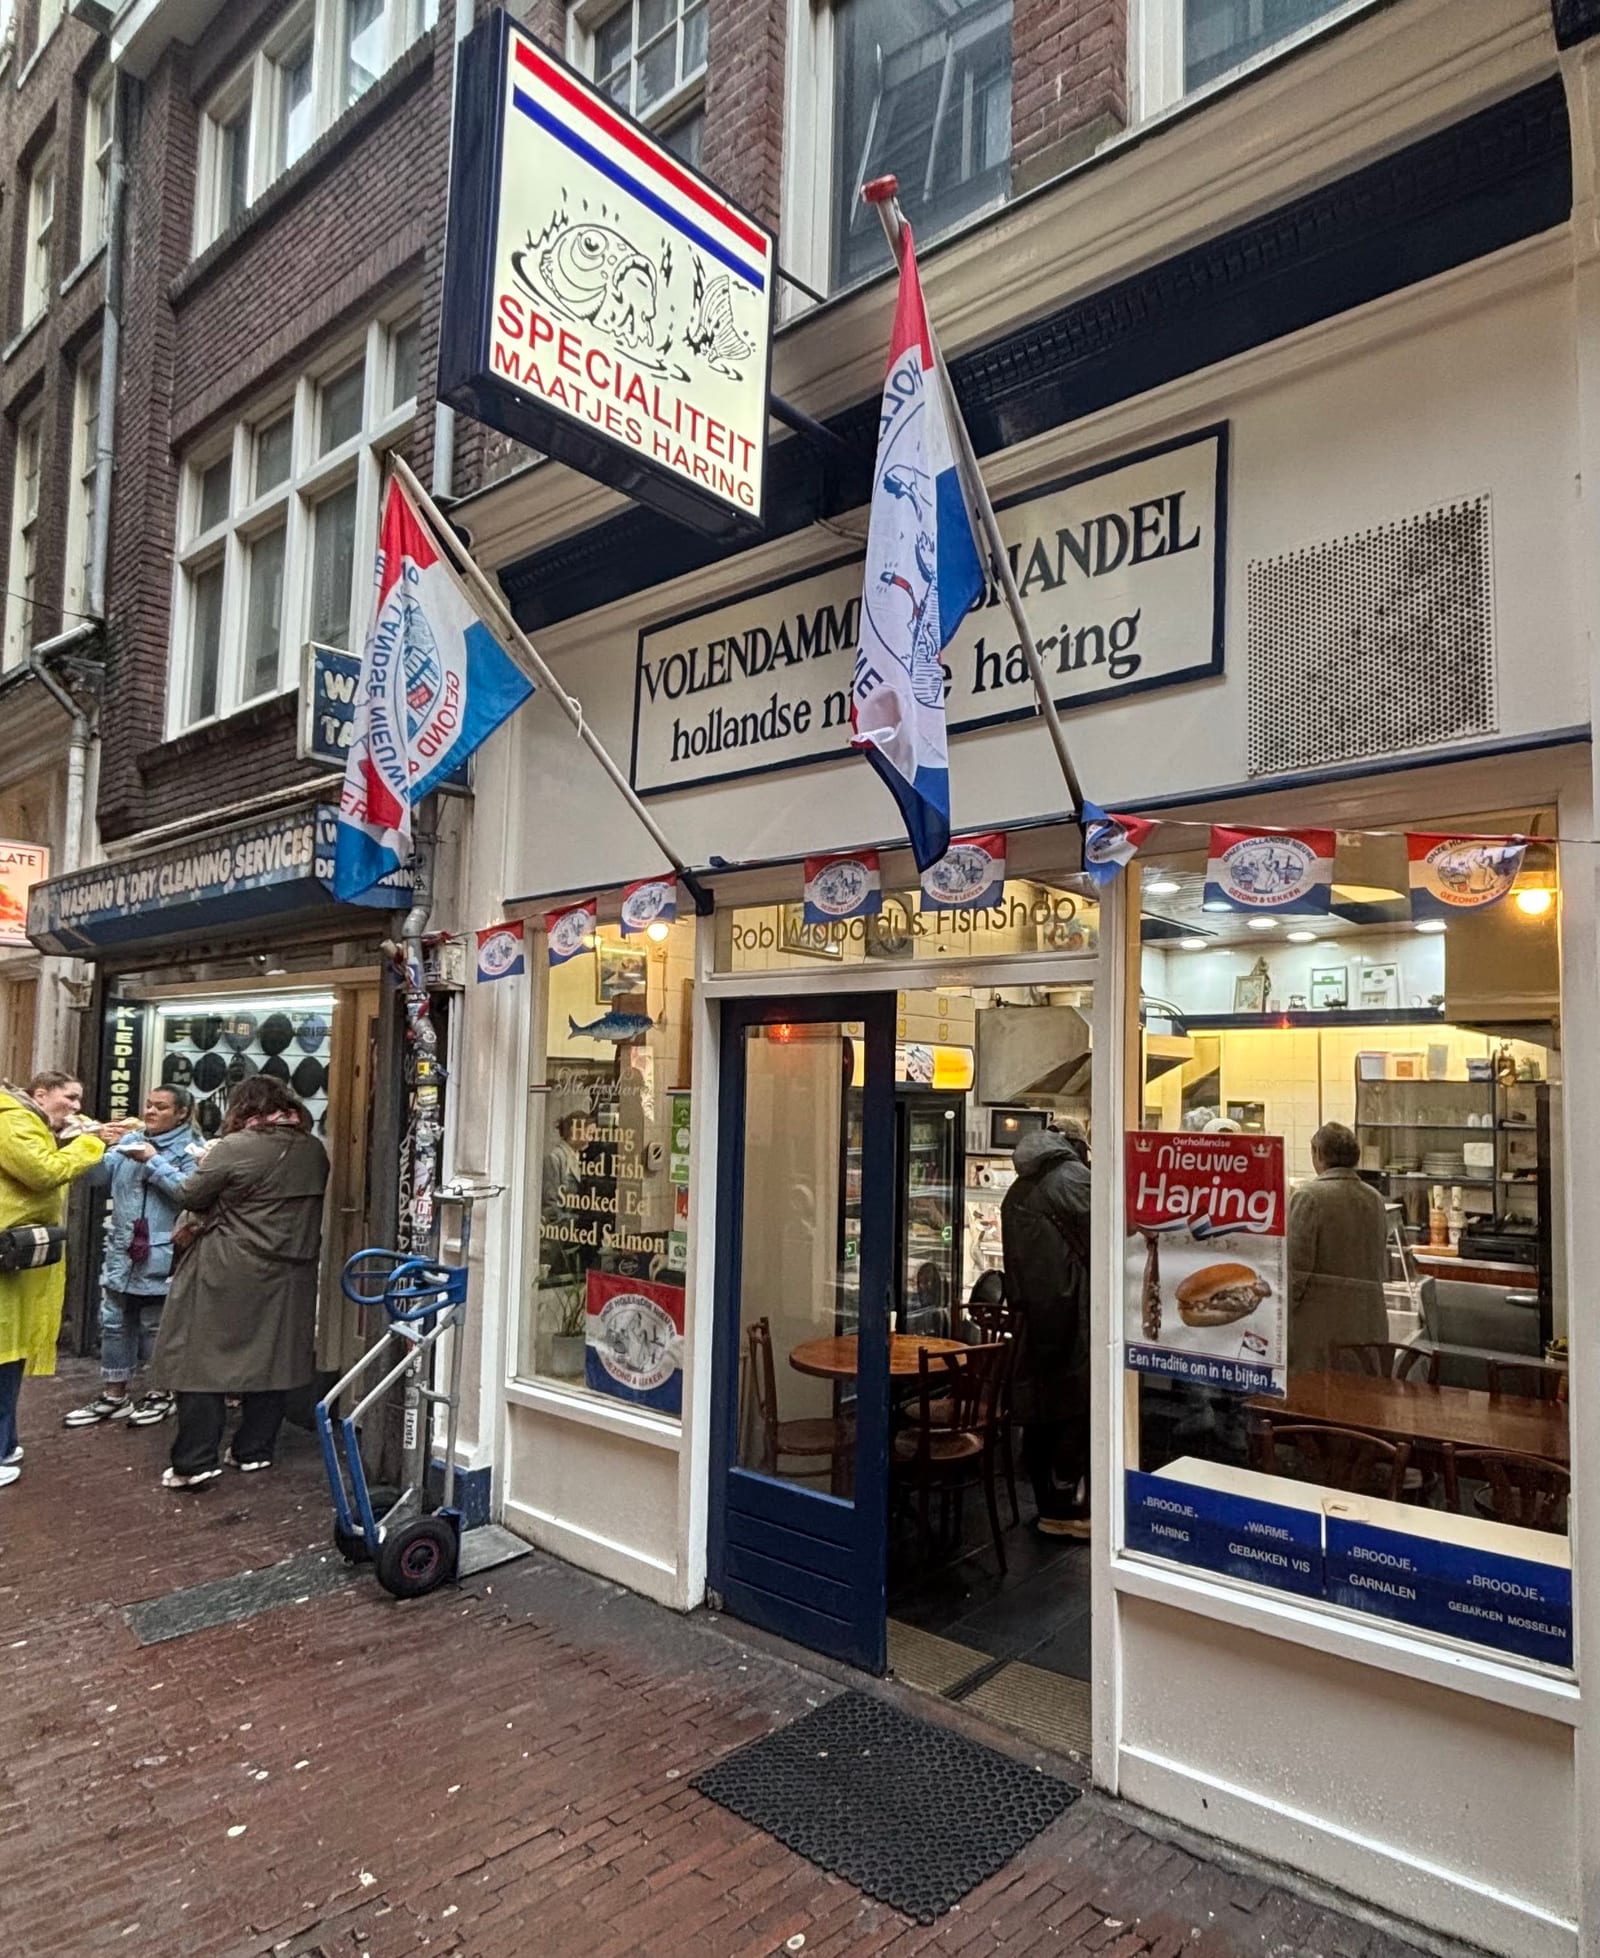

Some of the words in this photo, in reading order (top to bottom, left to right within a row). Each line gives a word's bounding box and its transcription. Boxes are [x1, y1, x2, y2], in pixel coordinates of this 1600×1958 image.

[499, 294, 756, 473] SPECIALITEIT
[494, 342, 642, 446] MAATJES
[653, 437, 755, 507] HARING
[641, 597, 863, 704] VOLENDAMM
[671, 692, 812, 762] hollandse
[60, 879, 113, 919] WASHING
[130, 869, 158, 903] DRY
[159, 849, 230, 896] CLEANING
[234, 825, 314, 878] SERVICES
[1228, 887, 1258, 903] GEZOND
[1266, 887, 1301, 903] LEKKER
[732, 921, 774, 951] Rob
[110, 1006, 136, 1120] KLEDINGRE
[571, 1118, 636, 1152] Herring
[610, 1153, 644, 1179] Fish
[556, 1184, 619, 1213] Smoked
[624, 1190, 651, 1216] Eel
[1136, 1171, 1277, 1233] Haring
[539, 1215, 598, 1246] Smoked
[601, 1223, 665, 1254] Salmon
[1128, 1347, 1149, 1367] Een
[1151, 1353, 1188, 1373] traditie
[1190, 1362, 1207, 1376] om
[1209, 1362, 1219, 1378] in
[1222, 1366, 1233, 1381] te
[1235, 1364, 1268, 1390] bijten
[1151, 1523, 1190, 1542] HARING
[1228, 1542, 1288, 1568] GEBAKKEN
[1291, 1558, 1311, 1573] VIS
[1349, 1573, 1417, 1600] GARNALEN
[1448, 1600, 1503, 1623] GEBAKKEN
[1507, 1615, 1567, 1638] MOSSELEN
